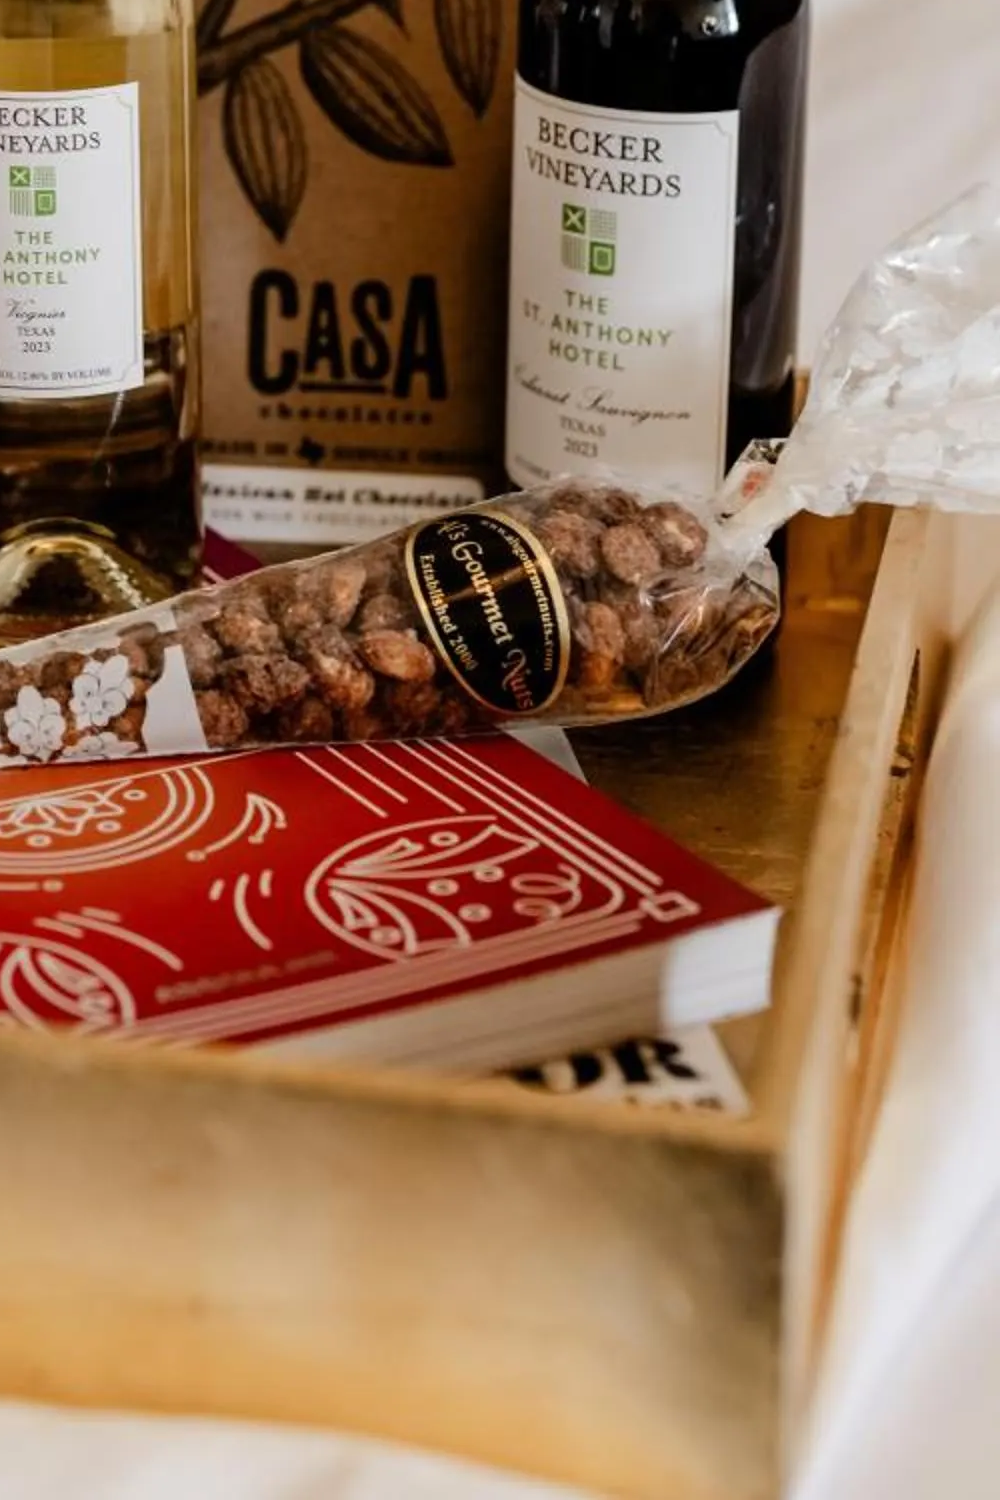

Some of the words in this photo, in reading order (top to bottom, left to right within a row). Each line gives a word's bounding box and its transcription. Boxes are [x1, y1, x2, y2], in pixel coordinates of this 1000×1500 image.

[538, 117, 663, 164] BECKER
[526, 146, 681, 199] VINEYARDS
[14, 231, 53, 245] THE
[3, 248, 101, 265] ANTHONY
[3, 271, 68, 286] HOTEL
[563, 289, 610, 316] THE
[17, 326, 56, 337] TEXAS
[247, 268, 447, 401] CASA
[523, 300, 545, 326] ST.
[551, 318, 673, 348] ANTHONY
[23, 341, 52, 353] 2023
[549, 339, 625, 371] HOTEL
[559, 415, 607, 437] TEXAS
[420, 554, 457, 634] Established
[451, 541, 514, 645] Gourmet
[502, 649, 534, 709] Nuts
